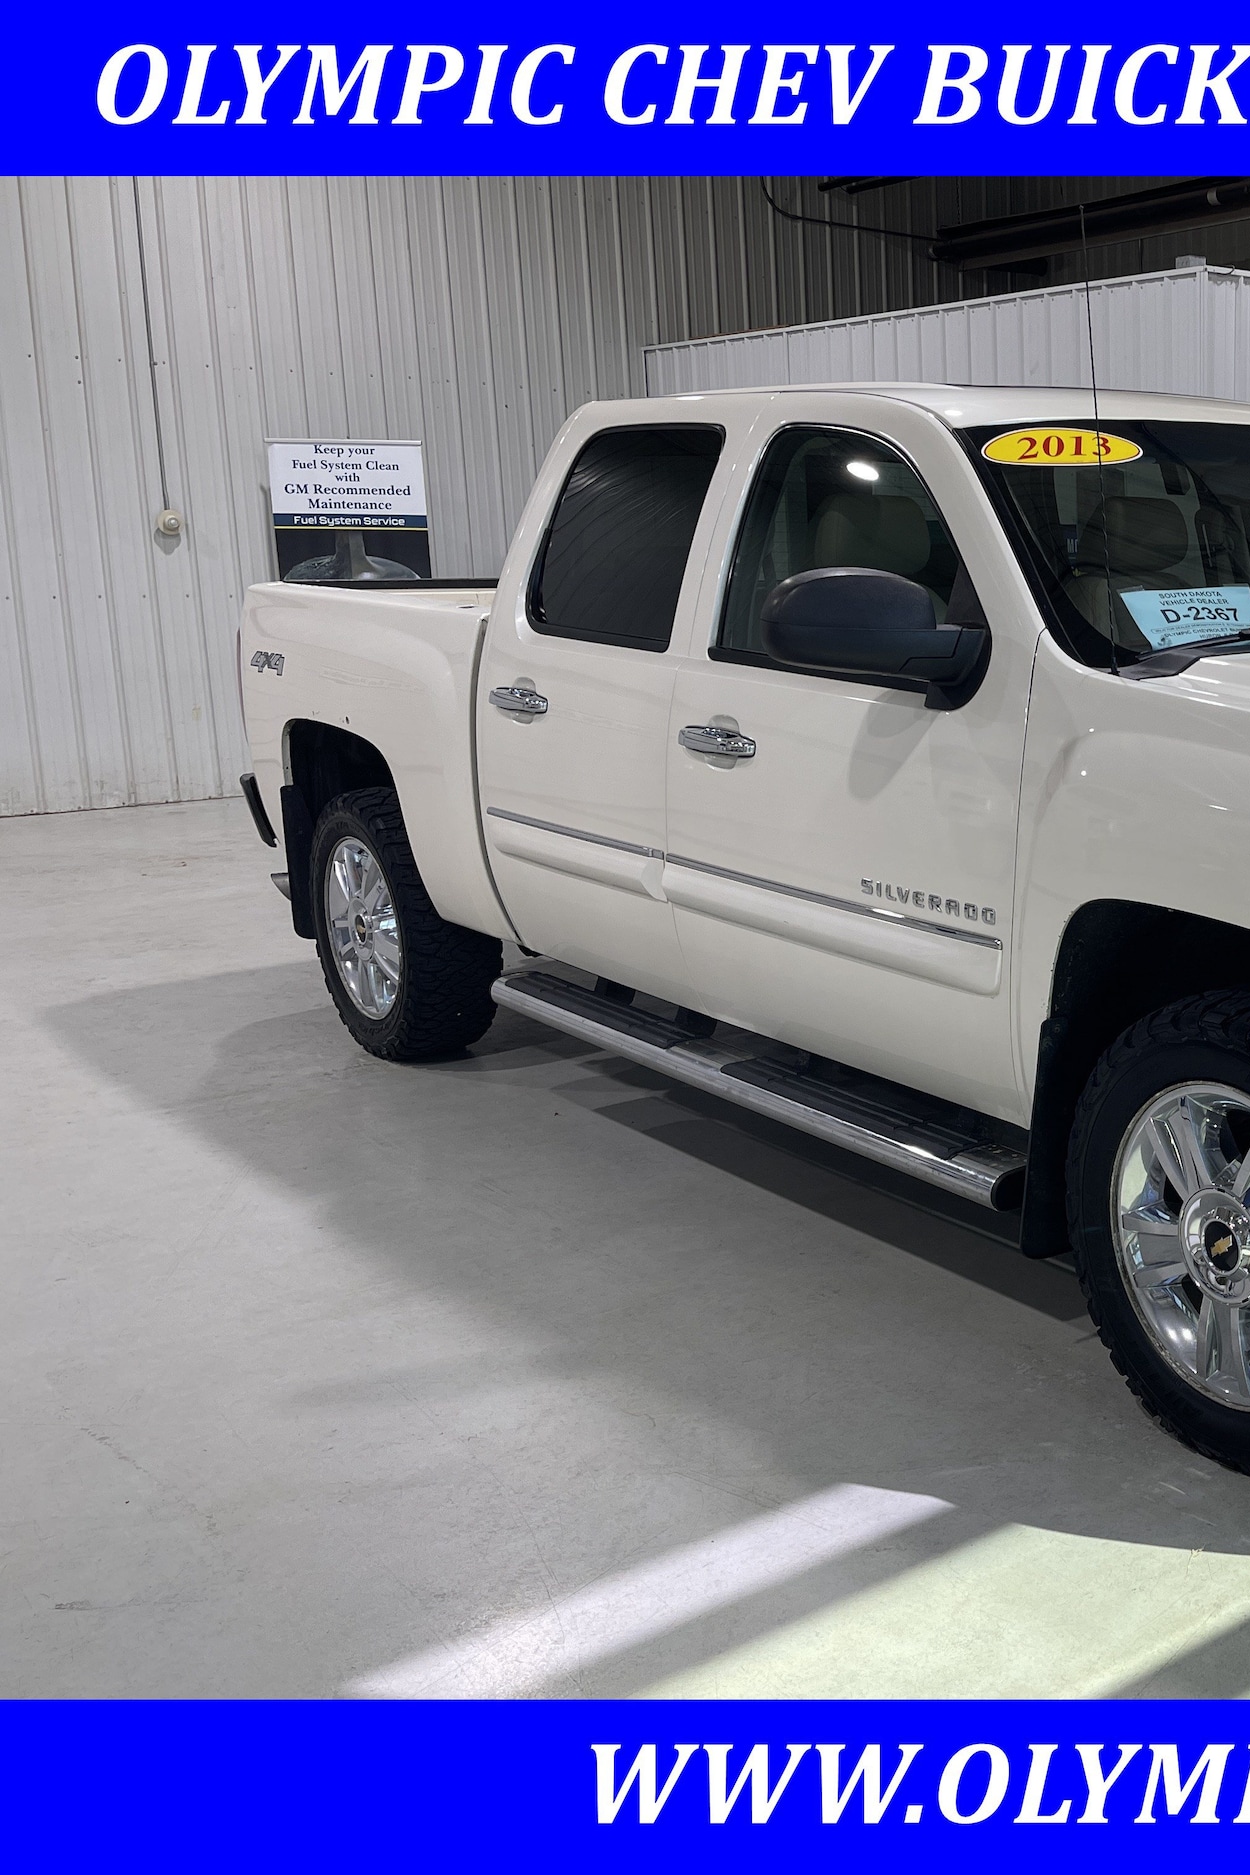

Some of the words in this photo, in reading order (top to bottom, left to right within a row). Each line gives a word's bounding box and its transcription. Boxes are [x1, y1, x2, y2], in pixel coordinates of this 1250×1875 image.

[314, 444, 344, 457] Keep
[348, 447, 375, 458] your
[1017, 435, 1111, 461] 2013
[292, 459, 317, 469] Fuel
[320, 459, 362, 472] System
[366, 460, 400, 471] Clean
[335, 472, 360, 482] with
[284, 483, 308, 494] GM
[313, 483, 411, 496] Recommended
[308, 498, 392, 510] Maintenance
[293, 515, 317, 525] Fuel
[319, 516, 361, 527] System
[363, 516, 405, 526] Service
[1159, 591, 1188, 599] SOUTH
[1160, 598, 1195, 606] VEHICLE
[1160, 606, 1239, 624] D-2367
[860, 877, 996, 926] SILVERADO
